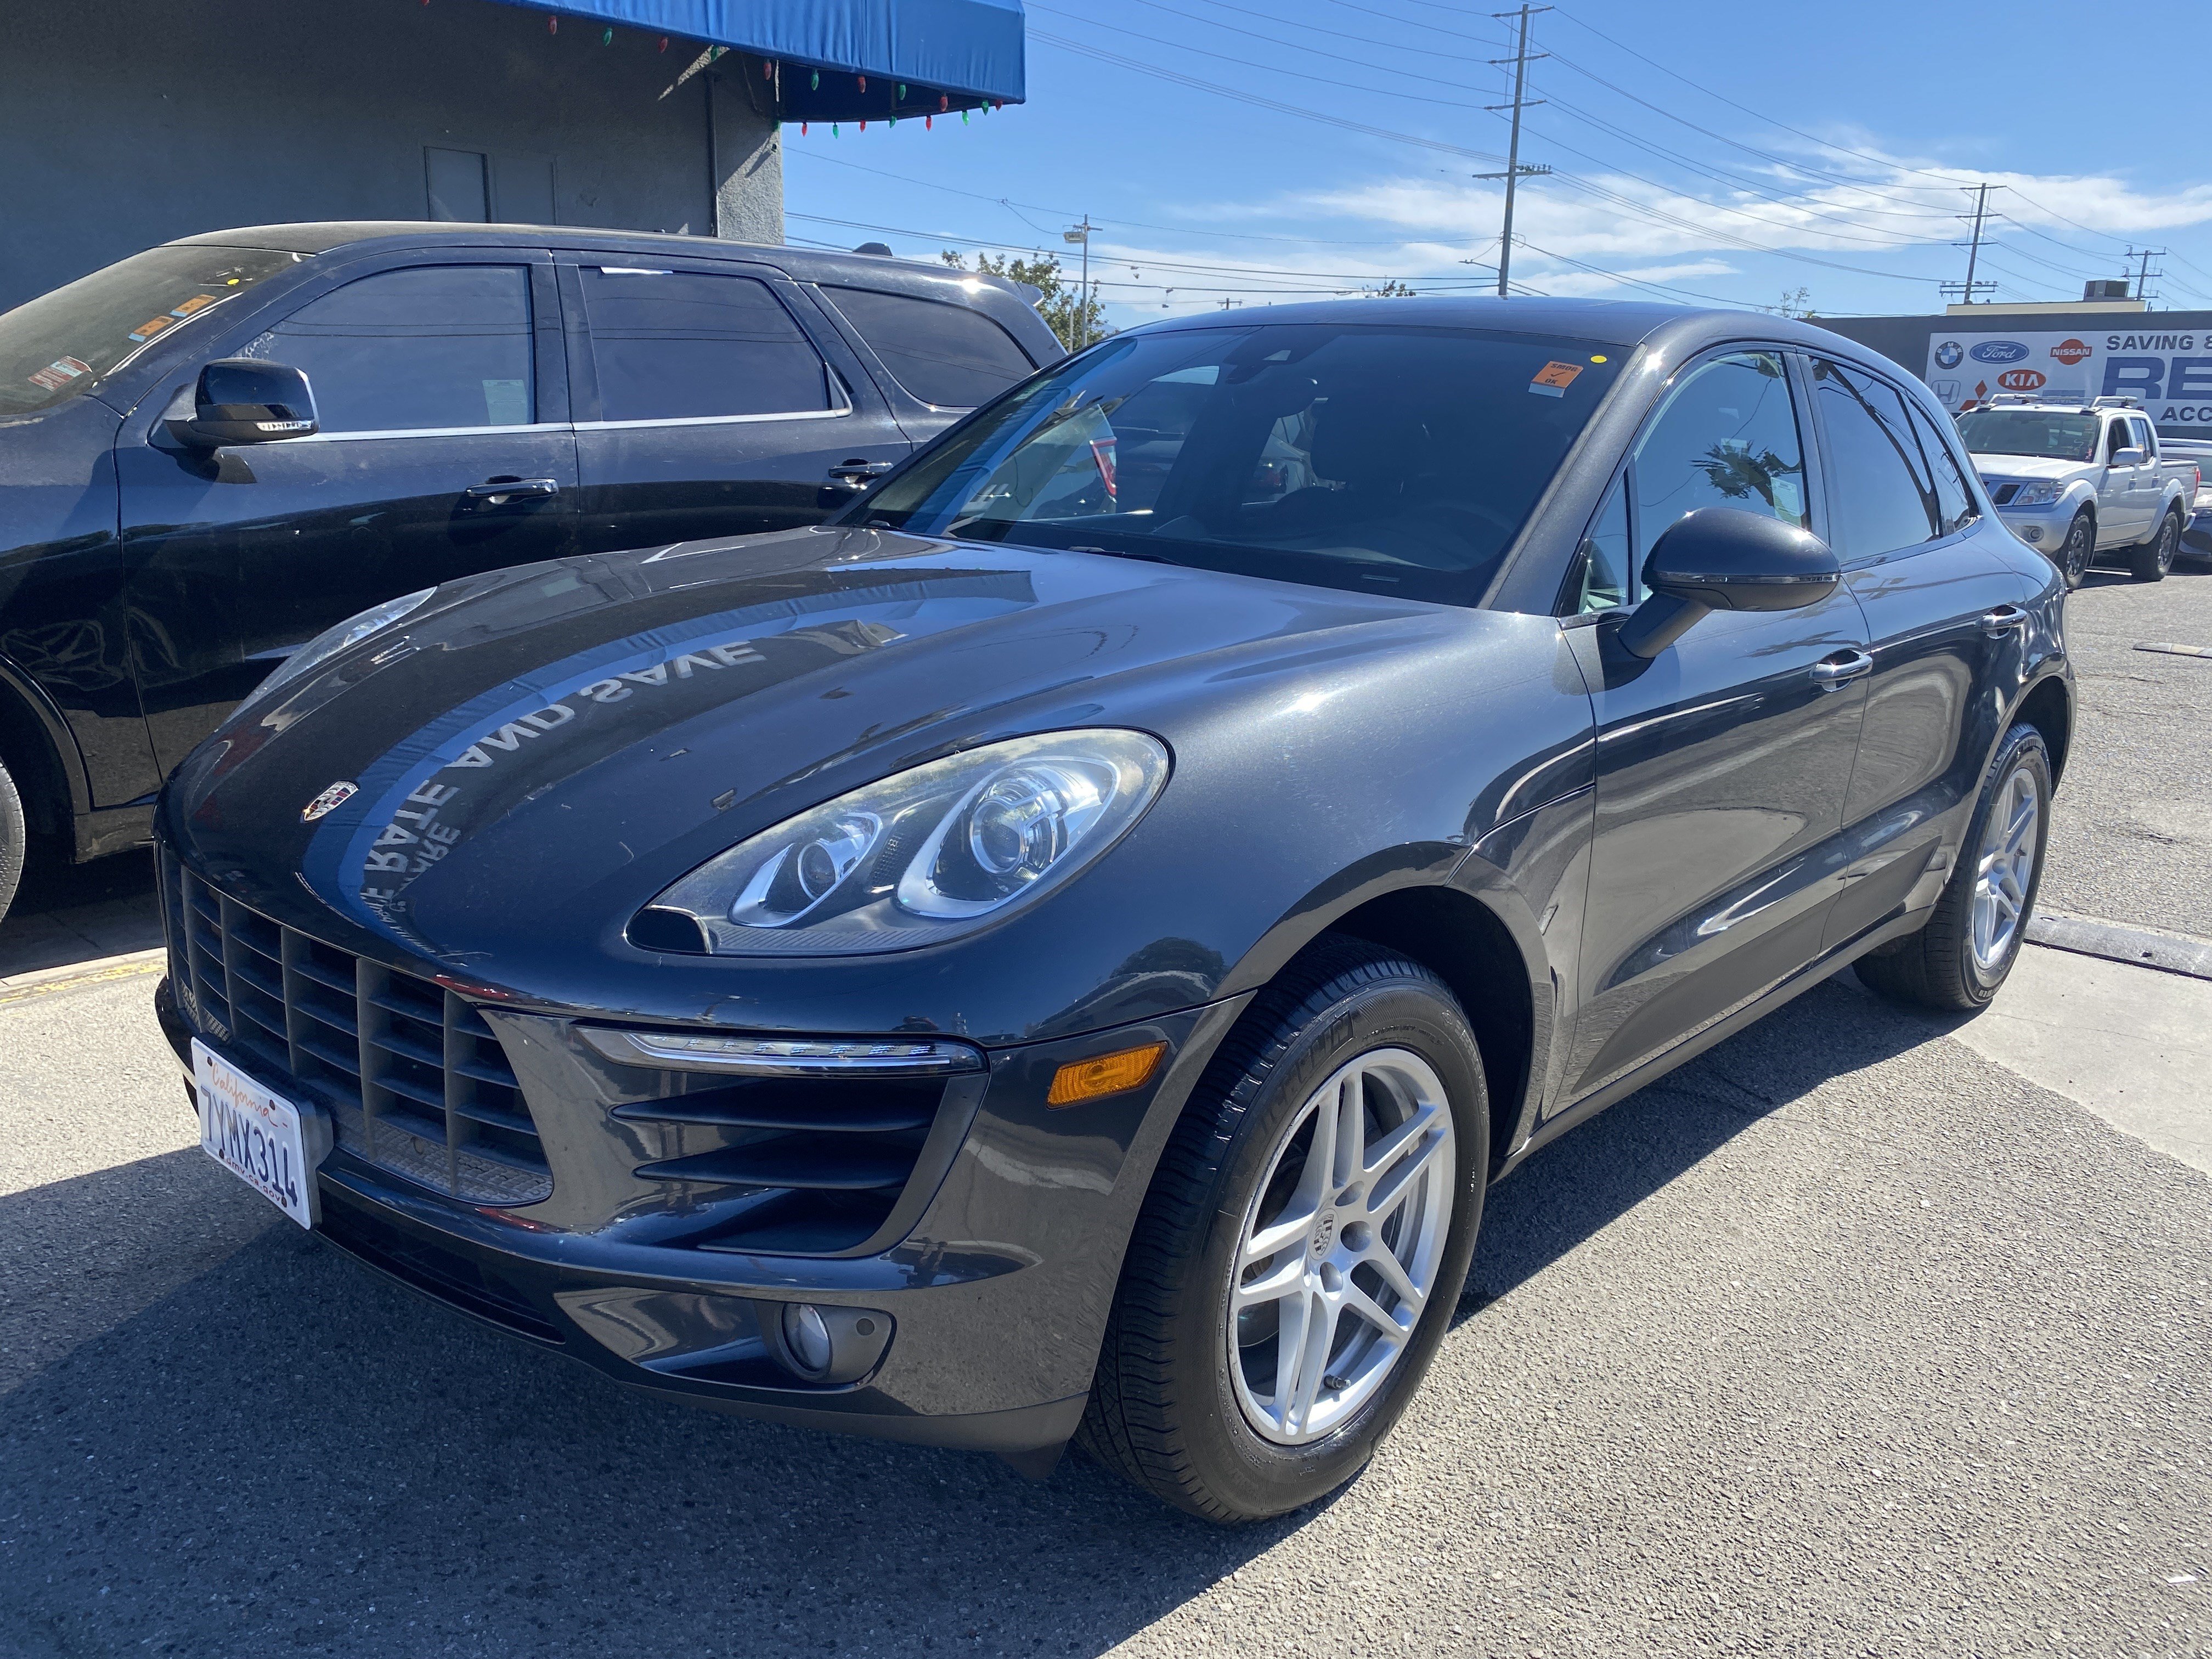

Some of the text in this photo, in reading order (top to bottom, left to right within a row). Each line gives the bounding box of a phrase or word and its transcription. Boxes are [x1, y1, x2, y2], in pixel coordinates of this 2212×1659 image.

[2106, 335, 2194, 351] SAVING
[1982, 346, 2015, 358] Ford
[1550, 363, 1578, 372] SMOG
[2005, 373, 2039, 386] KIA
[212, 1063, 279, 1127] California
[200, 1085, 298, 1207] 7YMX314
[226, 1158, 280, 1201] dmv.ca.gov
